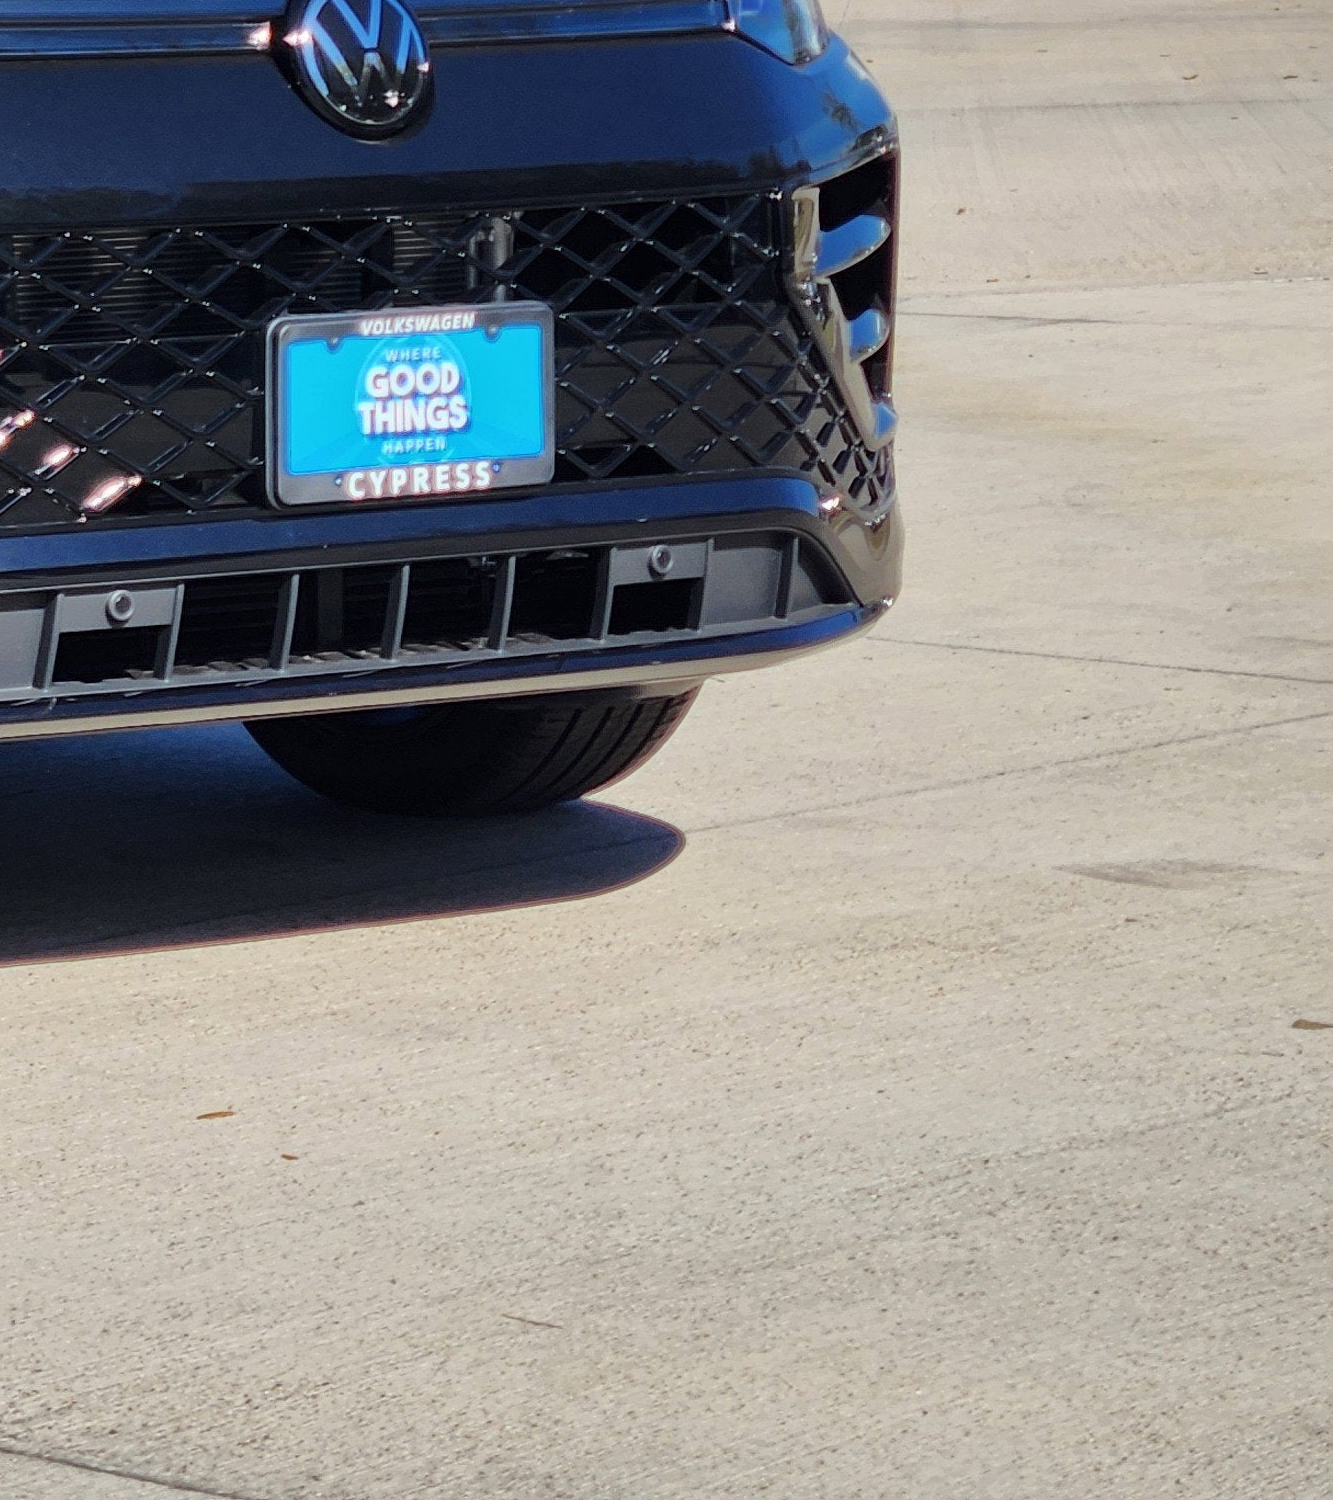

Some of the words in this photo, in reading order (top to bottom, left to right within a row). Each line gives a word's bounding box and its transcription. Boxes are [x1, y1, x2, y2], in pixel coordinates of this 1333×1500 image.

[360, 313, 476, 336] VOLKSWAGEN
[385, 347, 441, 363] WHERE
[365, 363, 460, 398] GOOD
[357, 394, 468, 435] THINGS
[382, 439, 447, 456] HAPPEN
[347, 461, 492, 499] CYPRESS
